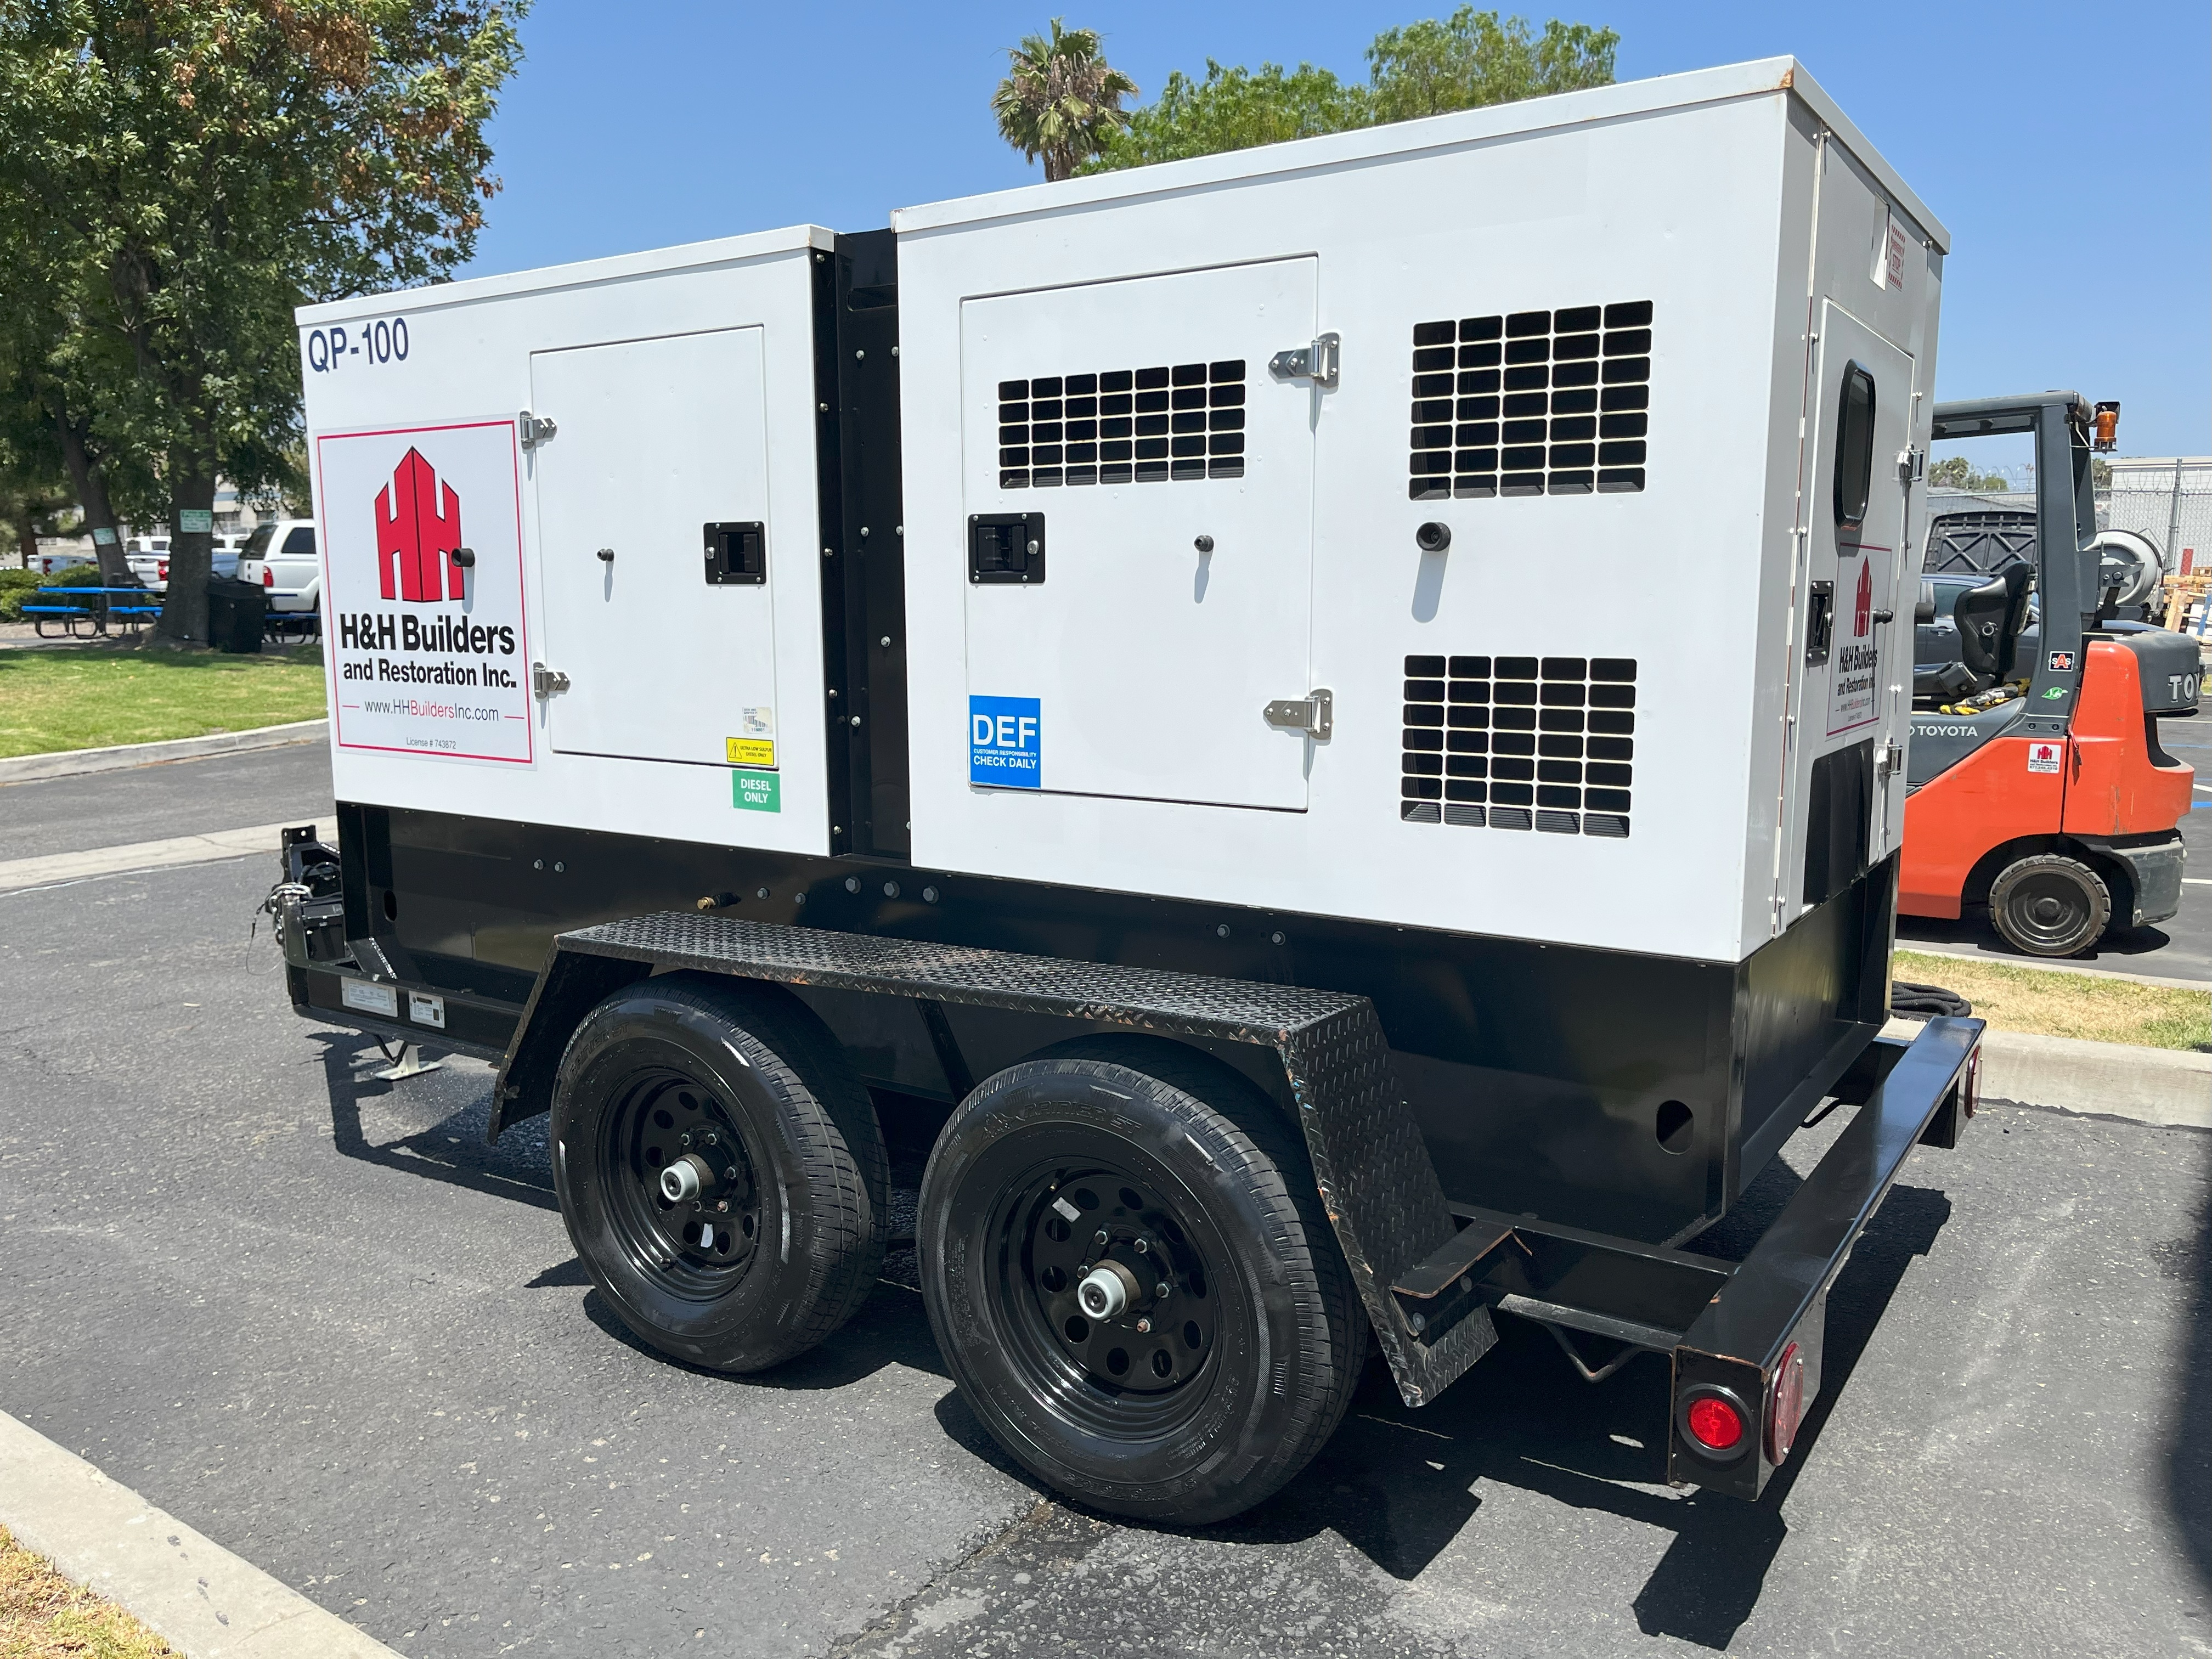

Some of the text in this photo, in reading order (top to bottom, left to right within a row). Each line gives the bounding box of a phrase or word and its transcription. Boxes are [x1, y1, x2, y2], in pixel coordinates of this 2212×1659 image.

[308, 318, 409, 373] QP-100
[340, 613, 515, 655] H&H Builders
[1854, 644, 1878, 671] Builders
[2051, 654, 2071, 669] SAS
[343, 658, 517, 688] and Restoration Inc.
[365, 699, 499, 721] www.HHBuildersInc.com
[973, 714, 1037, 748] DEF
[1917, 725, 1978, 737] TOYOTA
[407, 737, 428, 747] License
[435, 739, 456, 749] 743872
[973, 755, 1037, 769] CHECK DAILY
[741, 778, 772, 792] DIESEL
[744, 792, 768, 804] ONLY
[1024, 1101, 1142, 1134] RAINIER ST
